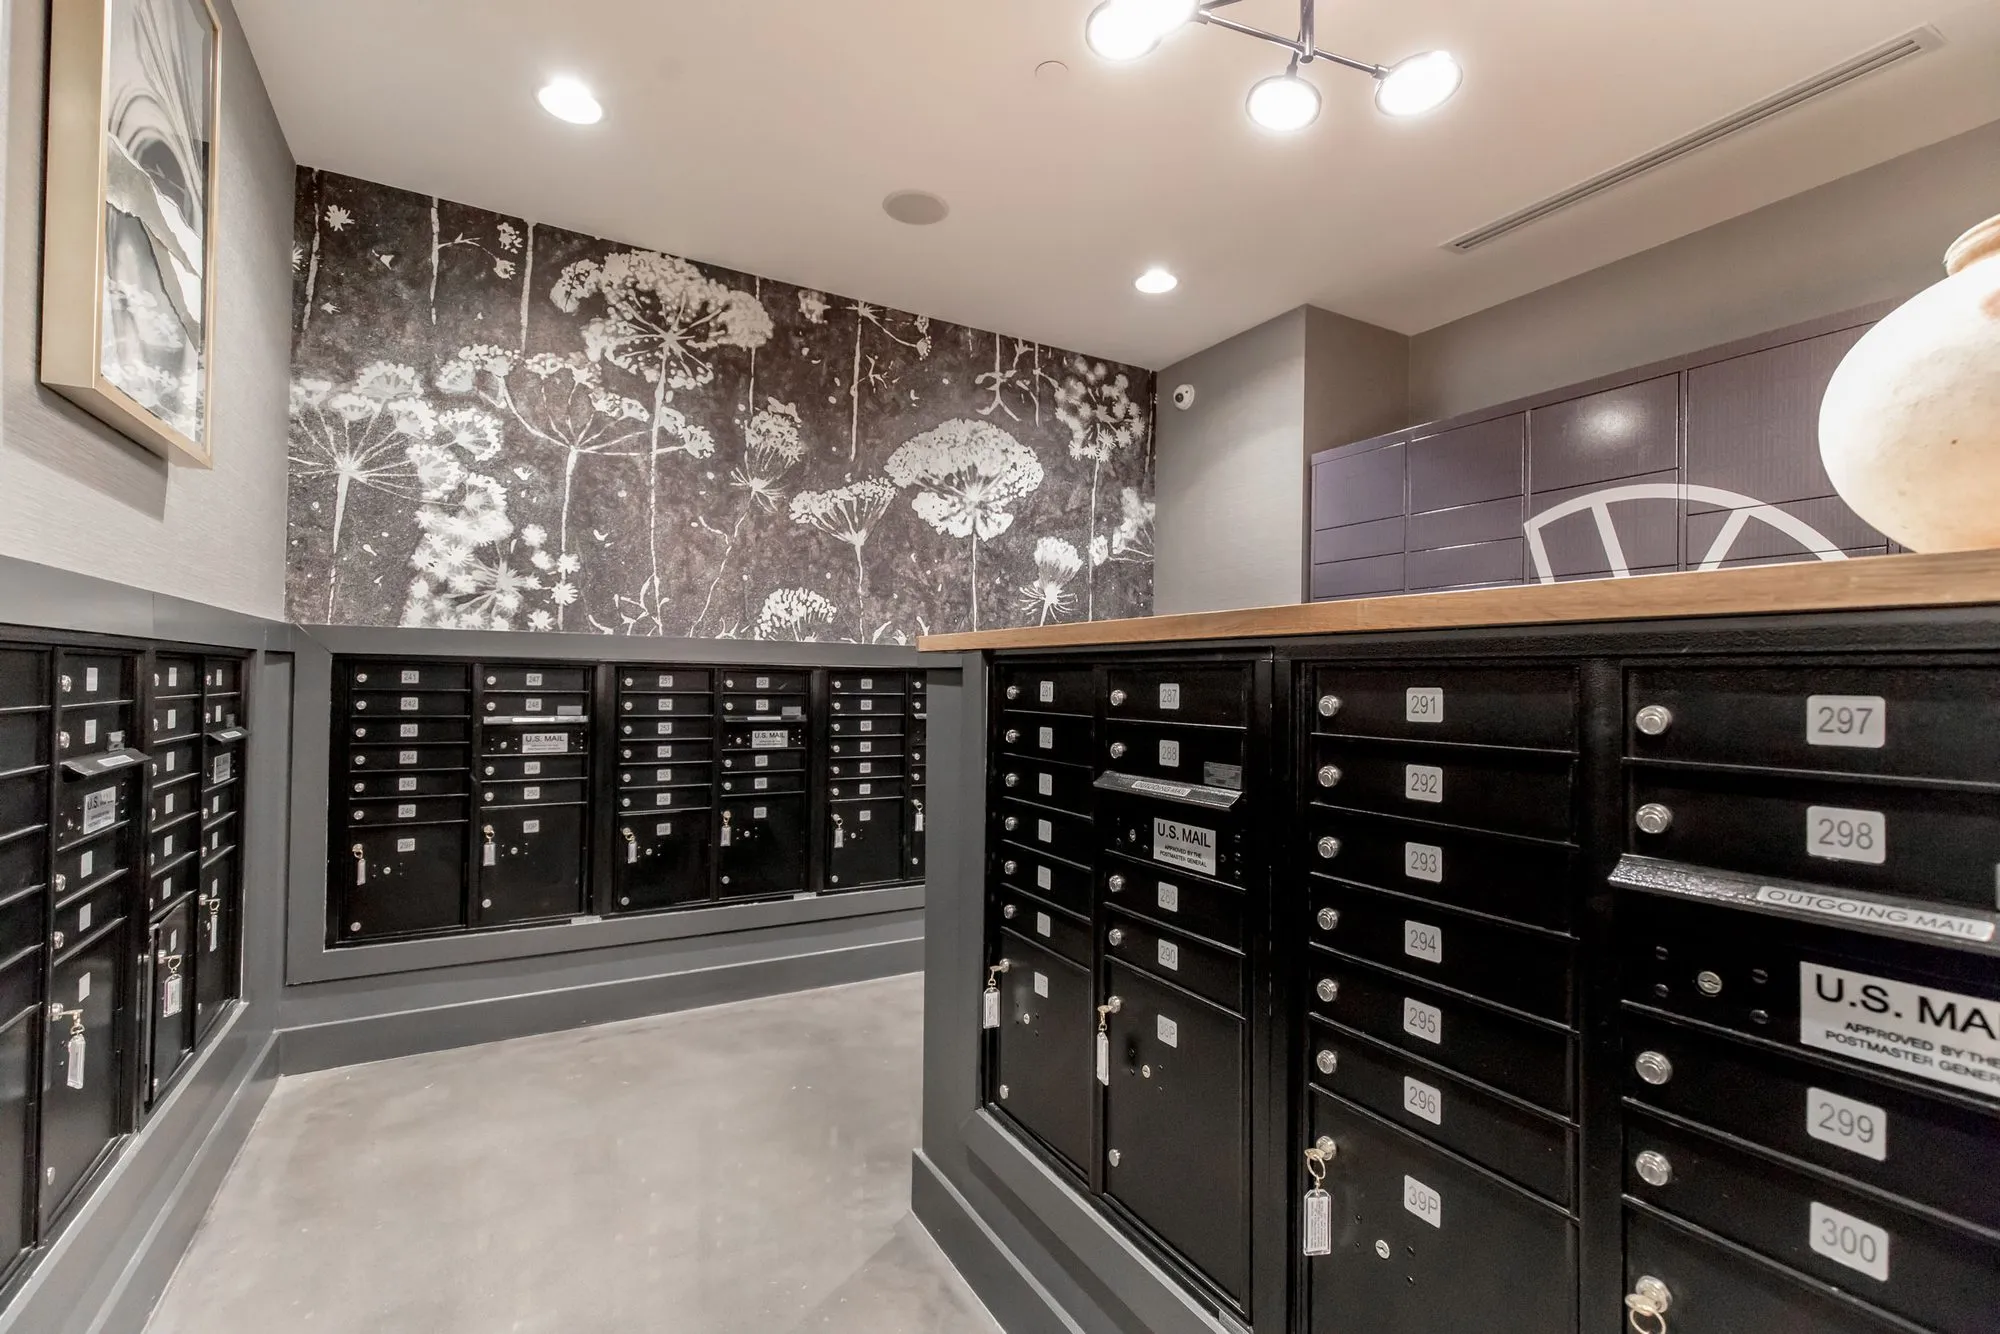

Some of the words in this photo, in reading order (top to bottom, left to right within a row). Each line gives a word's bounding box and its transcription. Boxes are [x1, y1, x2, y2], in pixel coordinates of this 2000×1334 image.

[404, 673, 416, 681] 241
[1162, 689, 1177, 703] 287
[1410, 695, 1436, 714] 291
[1817, 706, 1874, 735] 297
[1161, 747, 1177, 760] 288
[1410, 773, 1437, 793] 292
[1157, 822, 1179, 840] U.S.
[1182, 828, 1211, 848] MAIL
[1817, 818, 1874, 850] 298
[1164, 845, 1187, 855] APPROVED
[1410, 851, 1437, 873] 293
[1160, 889, 1176, 906] 289
[1767, 890, 1908, 922] OUTGOING
[1915, 915, 1977, 936] MAIL
[1409, 929, 1436, 953] 294
[1160, 945, 1176, 964] 290
[1815, 973, 1903, 1018] U.S.
[1917, 995, 2000, 1041] MA
[1409, 1007, 1436, 1034] 295
[1825, 1030, 1933, 1066] POSTMASTER
[1938, 1060, 2000, 1084] GENER
[1844, 1022, 1934, 1051] APPROVED
[1940, 1045, 1965, 1059] BY
[1967, 1051, 2000, 1069] THE
[1409, 1086, 1436, 1114] 296
[1818, 1102, 1874, 1143] 299
[1408, 1185, 1438, 1216] 39P
[1821, 1217, 1877, 1263] 300
